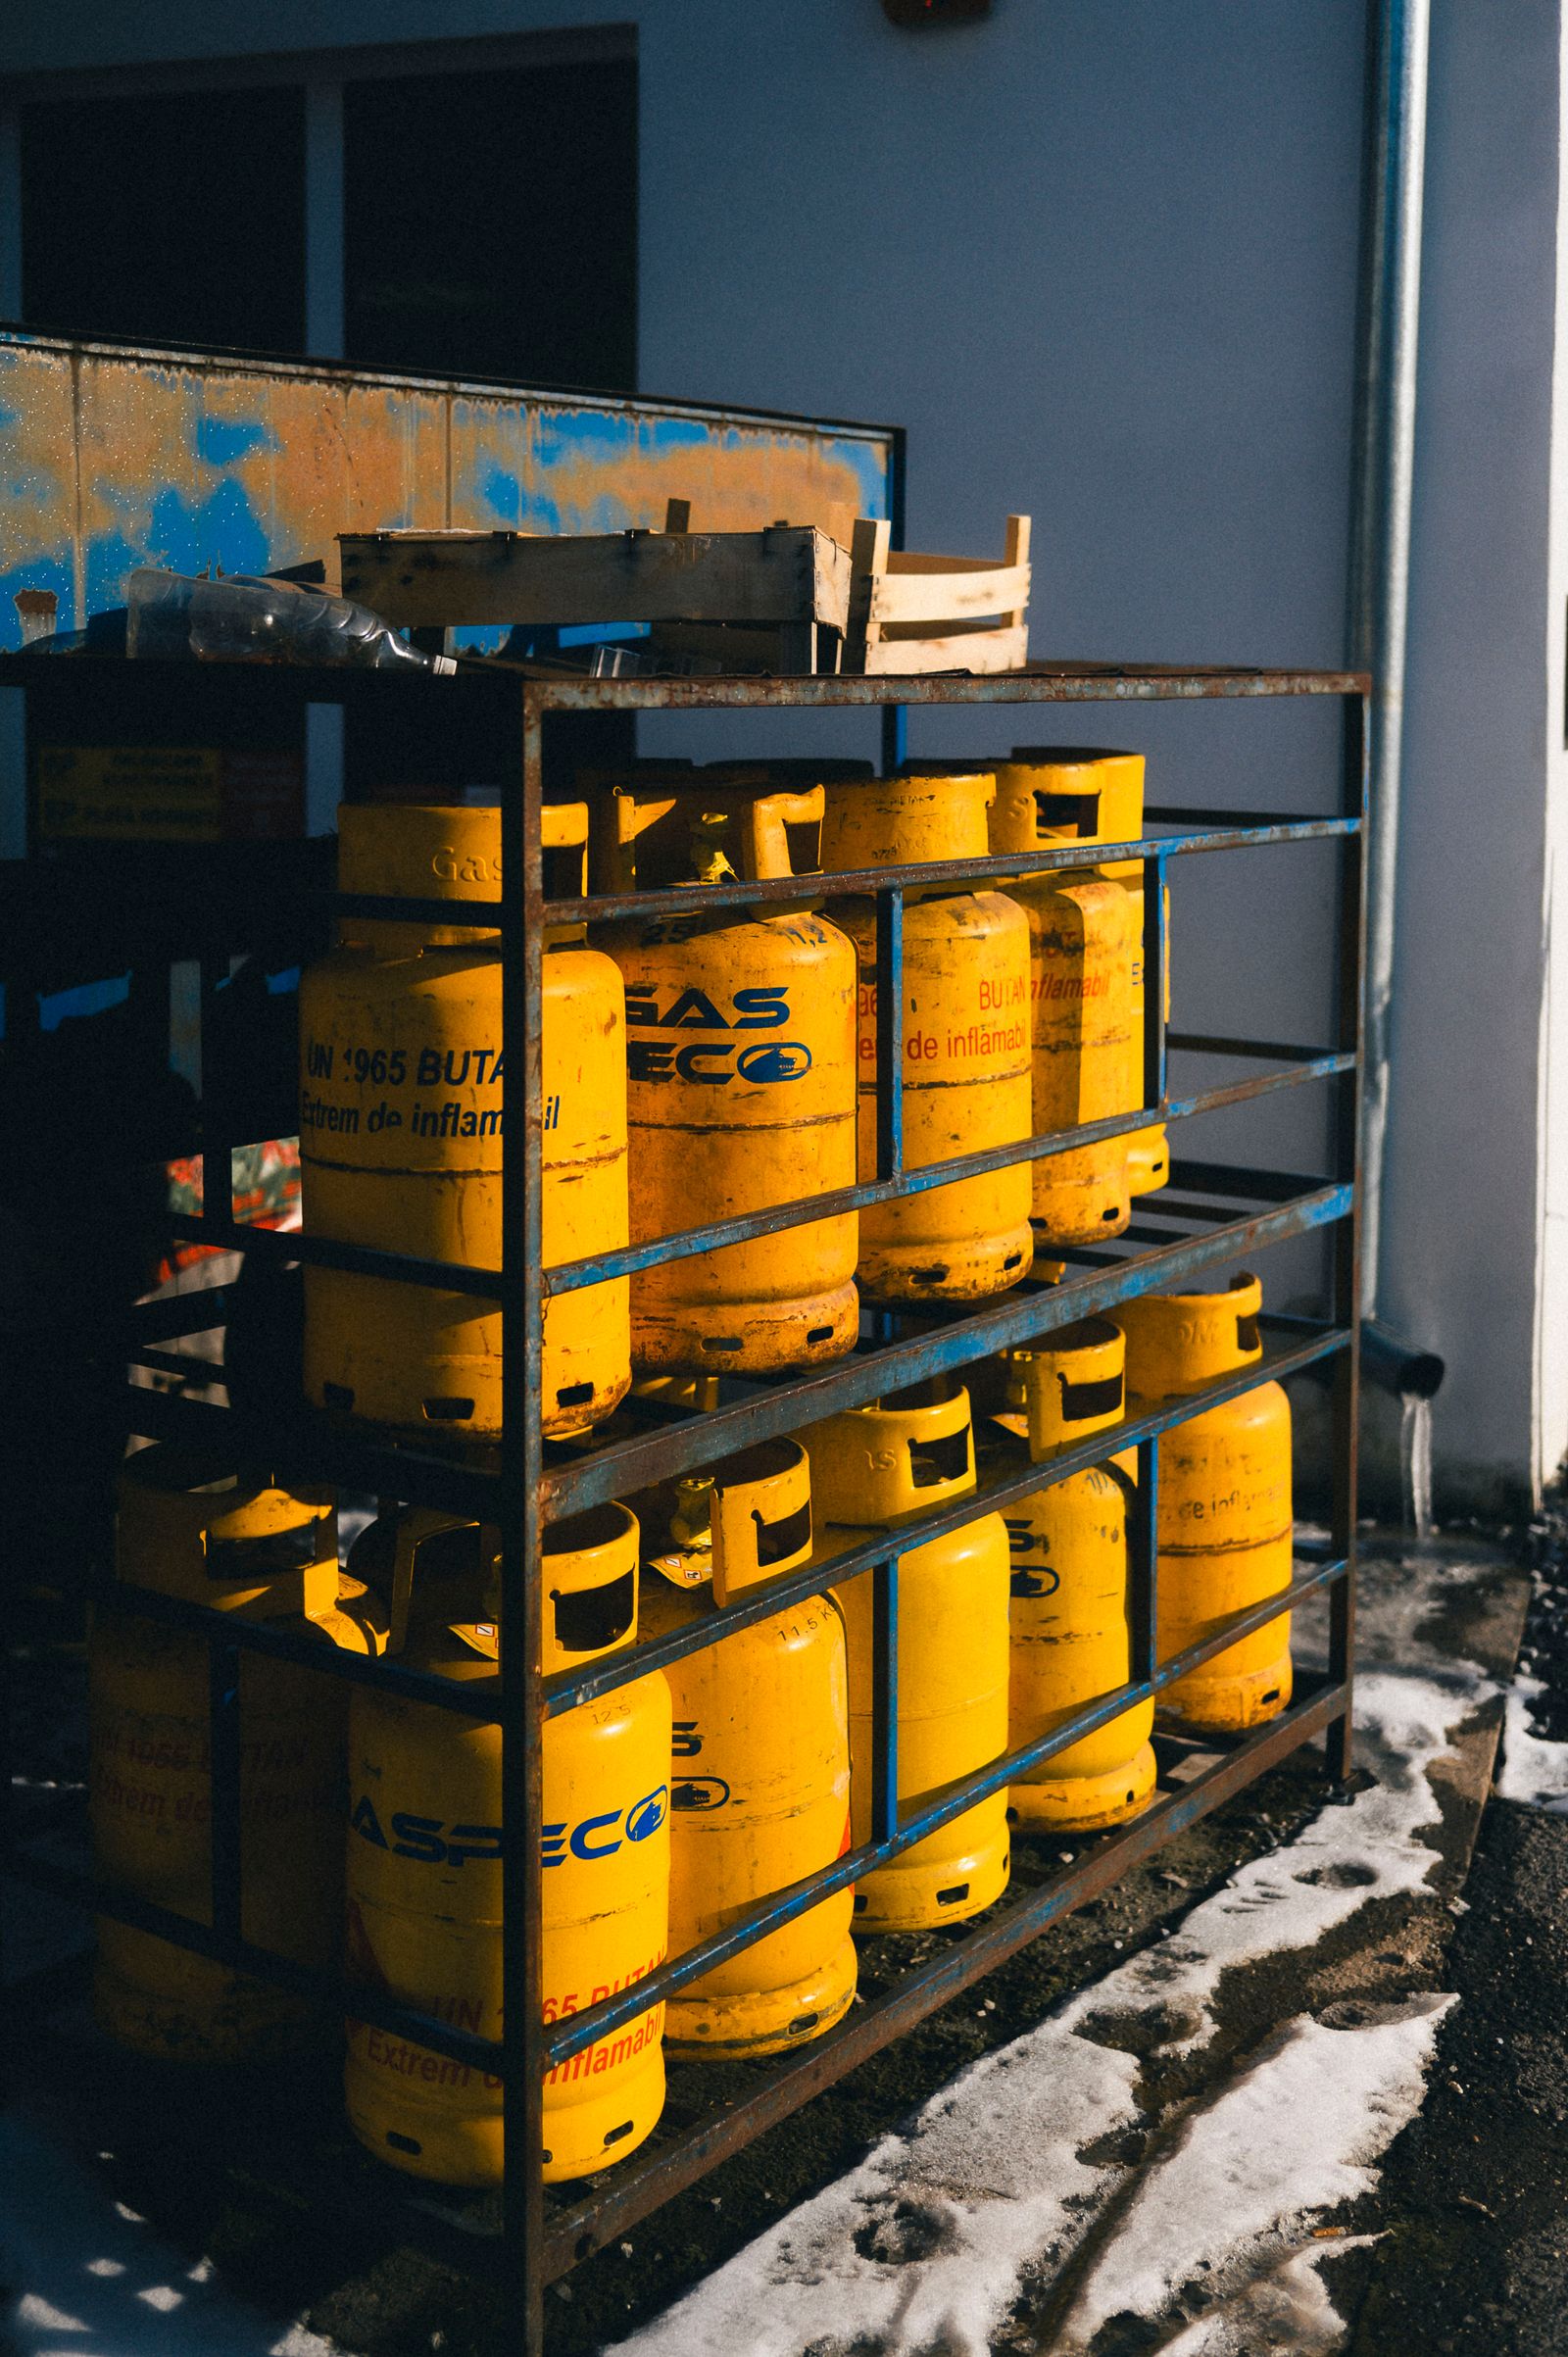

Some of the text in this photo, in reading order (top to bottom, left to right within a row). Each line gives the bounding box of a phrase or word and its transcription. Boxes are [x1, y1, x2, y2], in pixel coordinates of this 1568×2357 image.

[1031, 969, 1111, 1001] nflamabil
[906, 1029, 938, 1060] de
[948, 1018, 1026, 1058] inflamabil
[308, 1041, 333, 1080] UN
[417, 1049, 508, 1087] BUTA
[368, 1101, 403, 1133] de
[412, 1095, 560, 1138] inflamil
[350, 1784, 668, 1868] ASPECO
[542, 2000, 663, 2087] nflamabil
